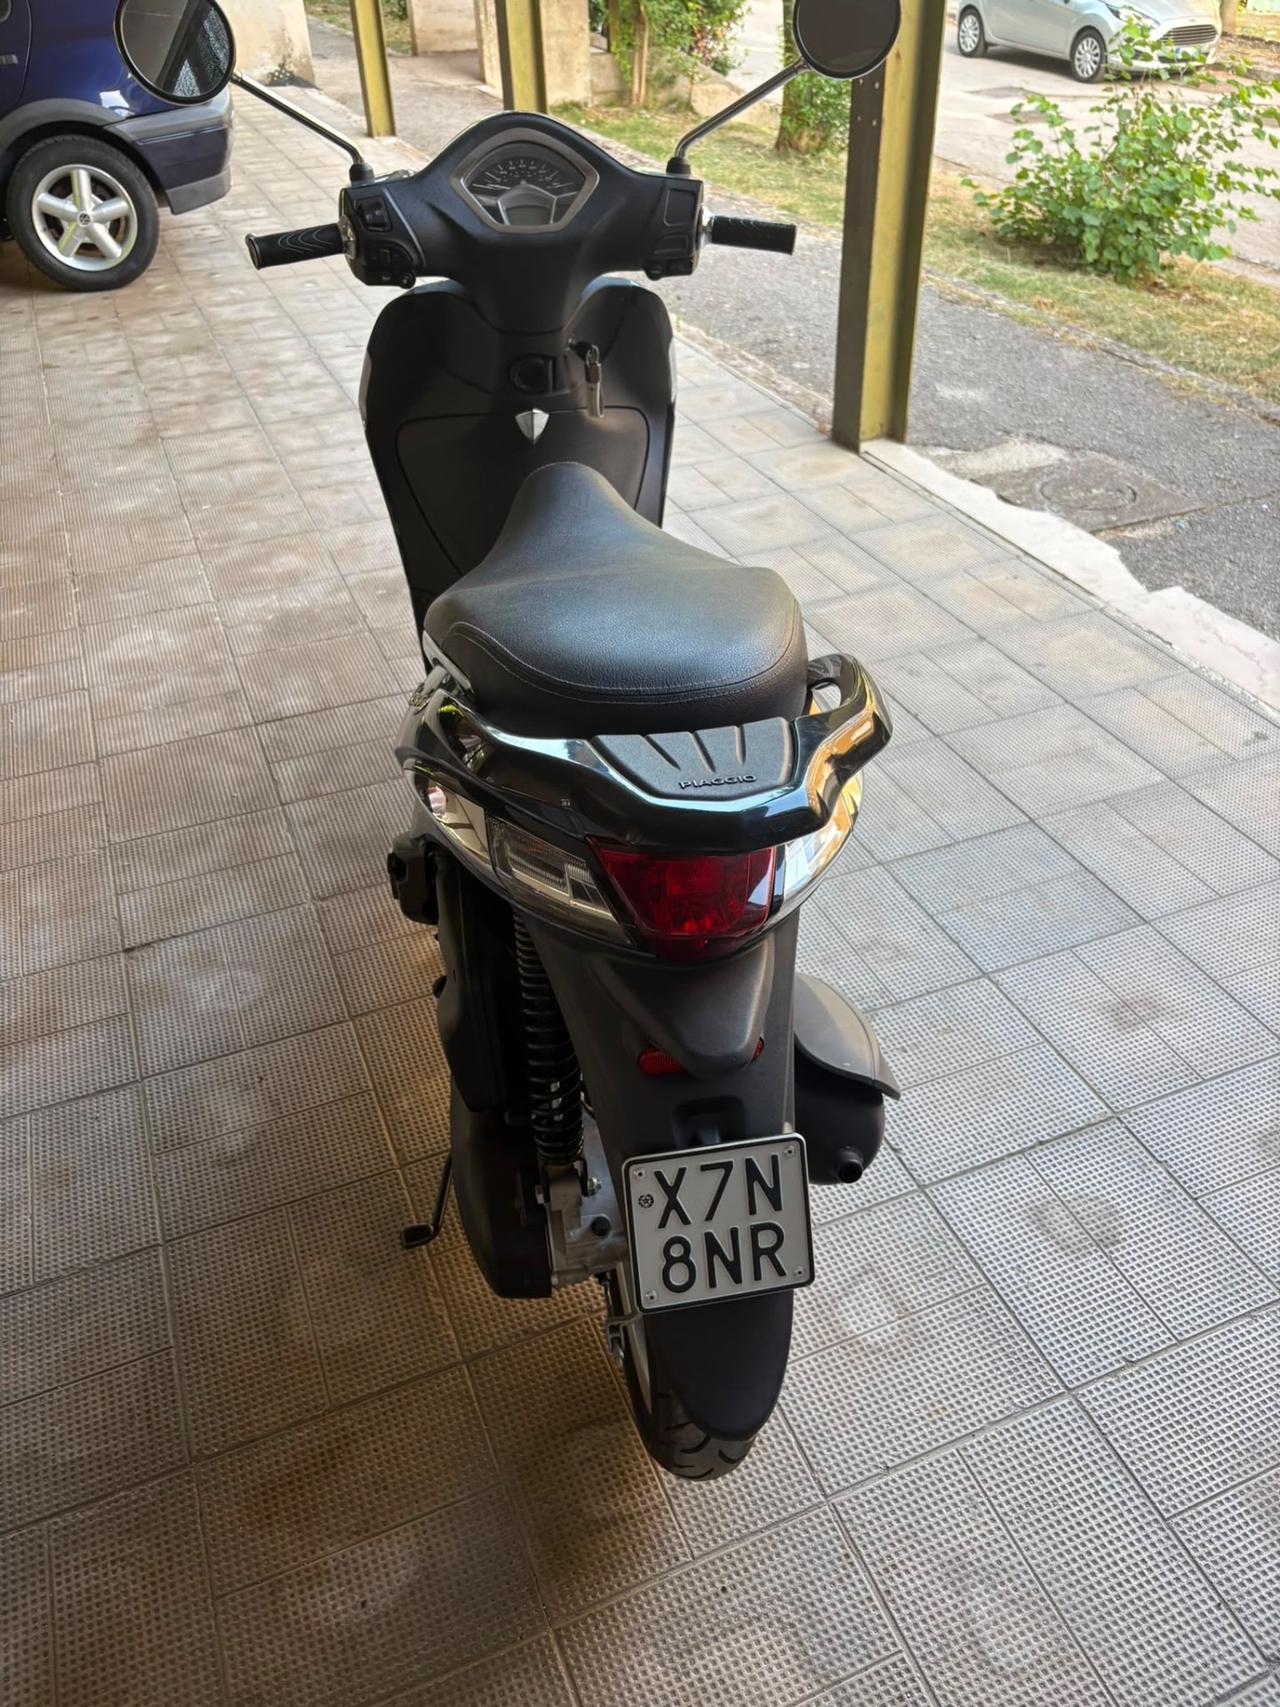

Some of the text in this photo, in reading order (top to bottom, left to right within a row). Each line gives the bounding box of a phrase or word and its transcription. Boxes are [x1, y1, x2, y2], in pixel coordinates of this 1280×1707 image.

[679, 775, 757, 789] PIAGGIO
[654, 1154, 782, 1229] X7N
[662, 1221, 787, 1294] 8NR
